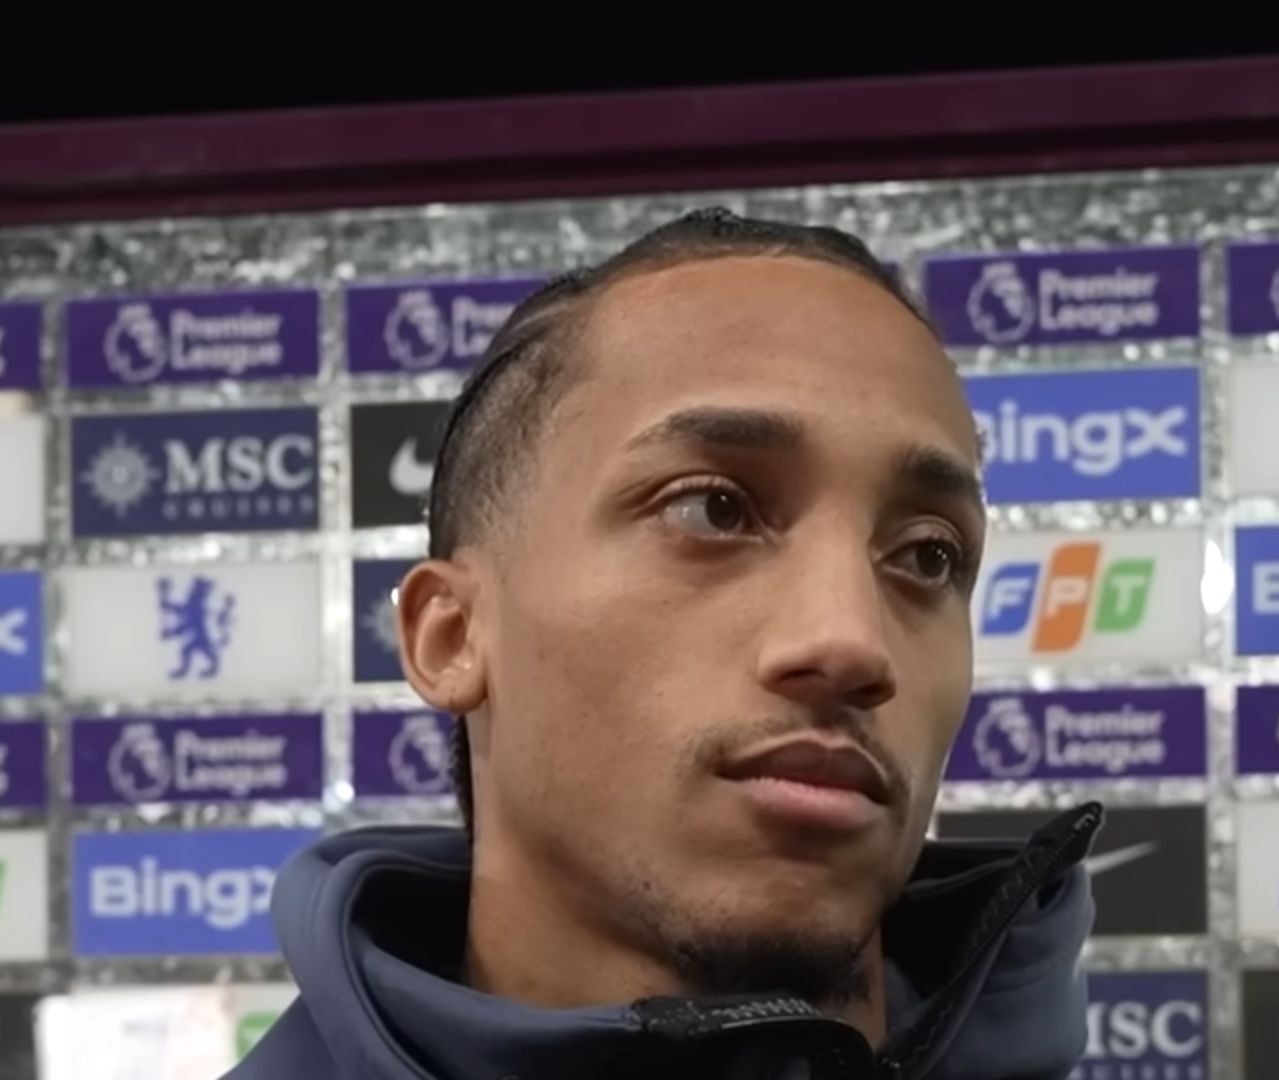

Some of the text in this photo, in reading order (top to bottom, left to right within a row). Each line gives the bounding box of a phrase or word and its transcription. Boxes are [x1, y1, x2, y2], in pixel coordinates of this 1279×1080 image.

[1039, 265, 1156, 304] Premier
[171, 307, 280, 343] Premier
[1039, 298, 1158, 338] League
[171, 338, 281, 377] League
[163, 434, 313, 493] MSC
[1045, 702, 1162, 740] Premier
[175, 729, 284, 763] Premier
[1045, 736, 1164, 775] League
[175, 760, 286, 798] League
